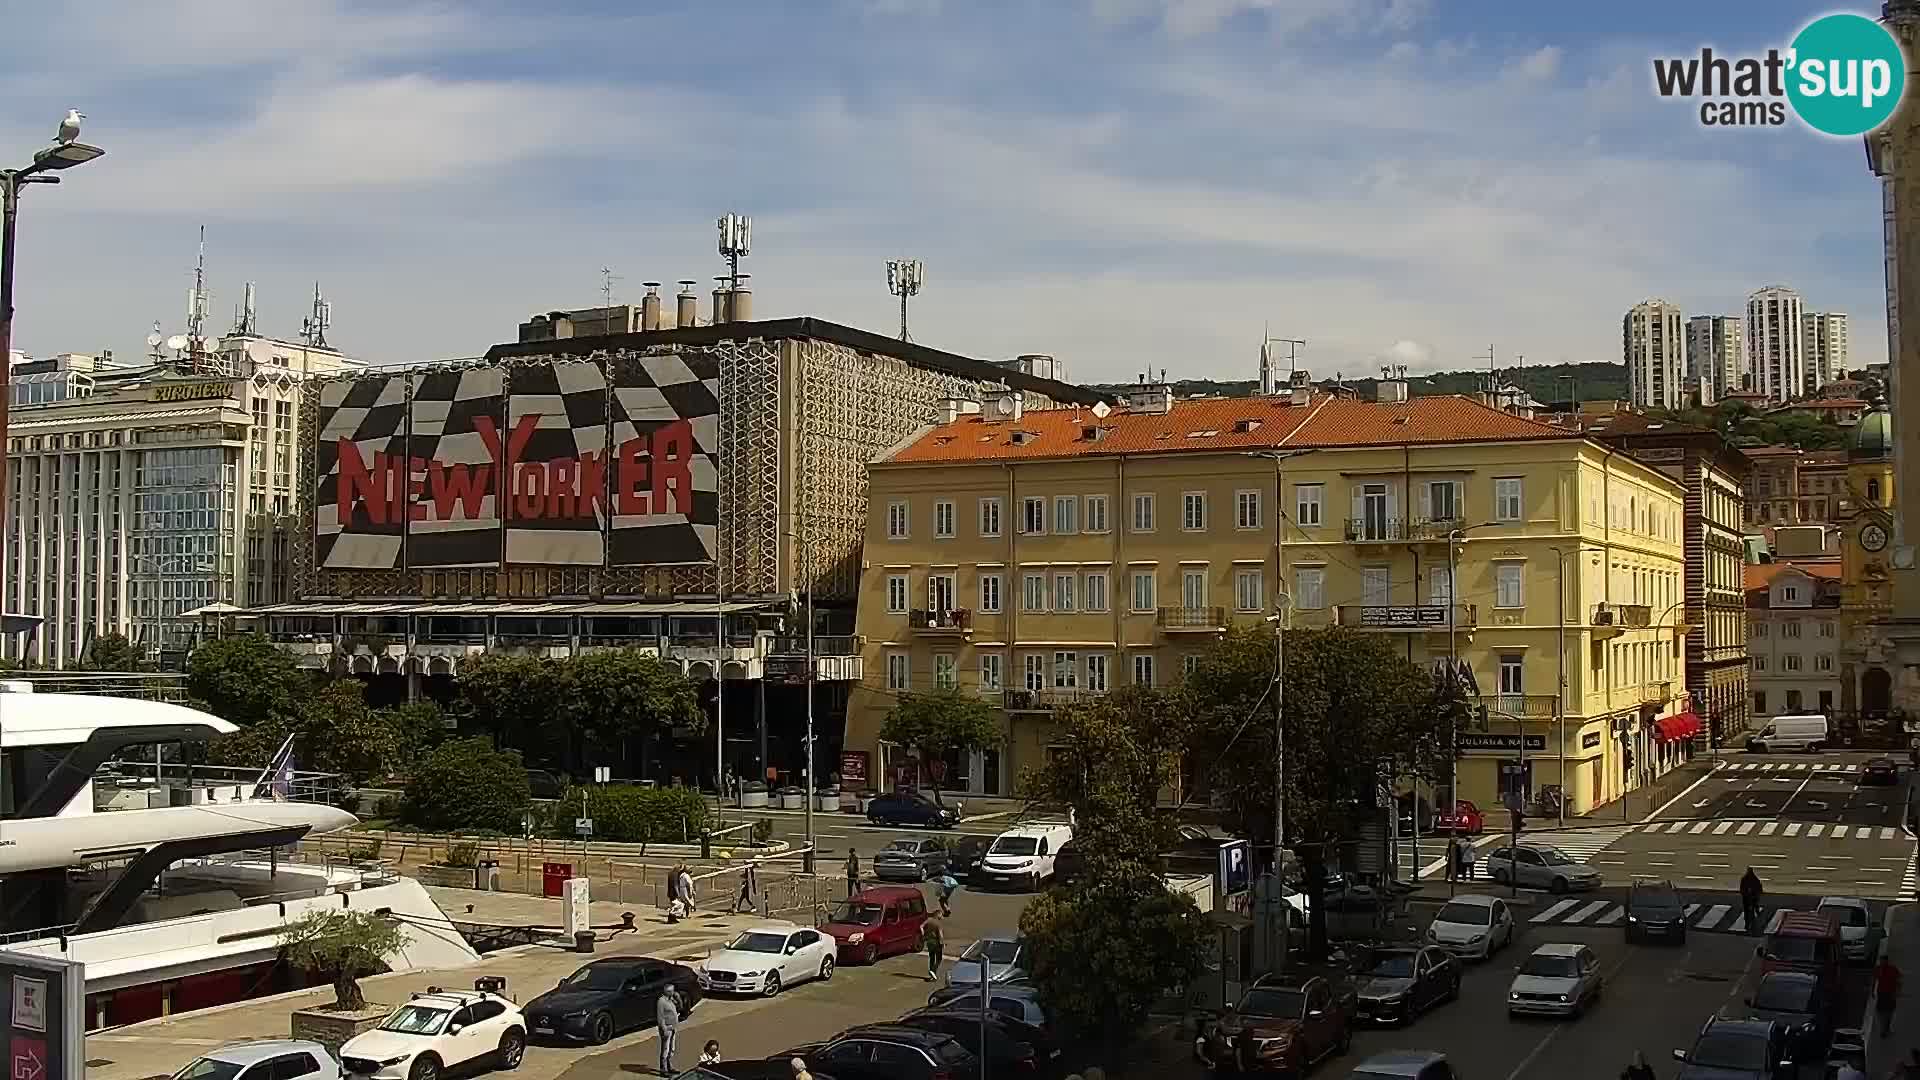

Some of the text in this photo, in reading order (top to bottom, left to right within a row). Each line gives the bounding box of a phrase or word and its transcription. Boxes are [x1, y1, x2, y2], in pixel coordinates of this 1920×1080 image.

[337, 413, 693, 527] NEW YORKER
[1231, 848, 1243, 872] P
